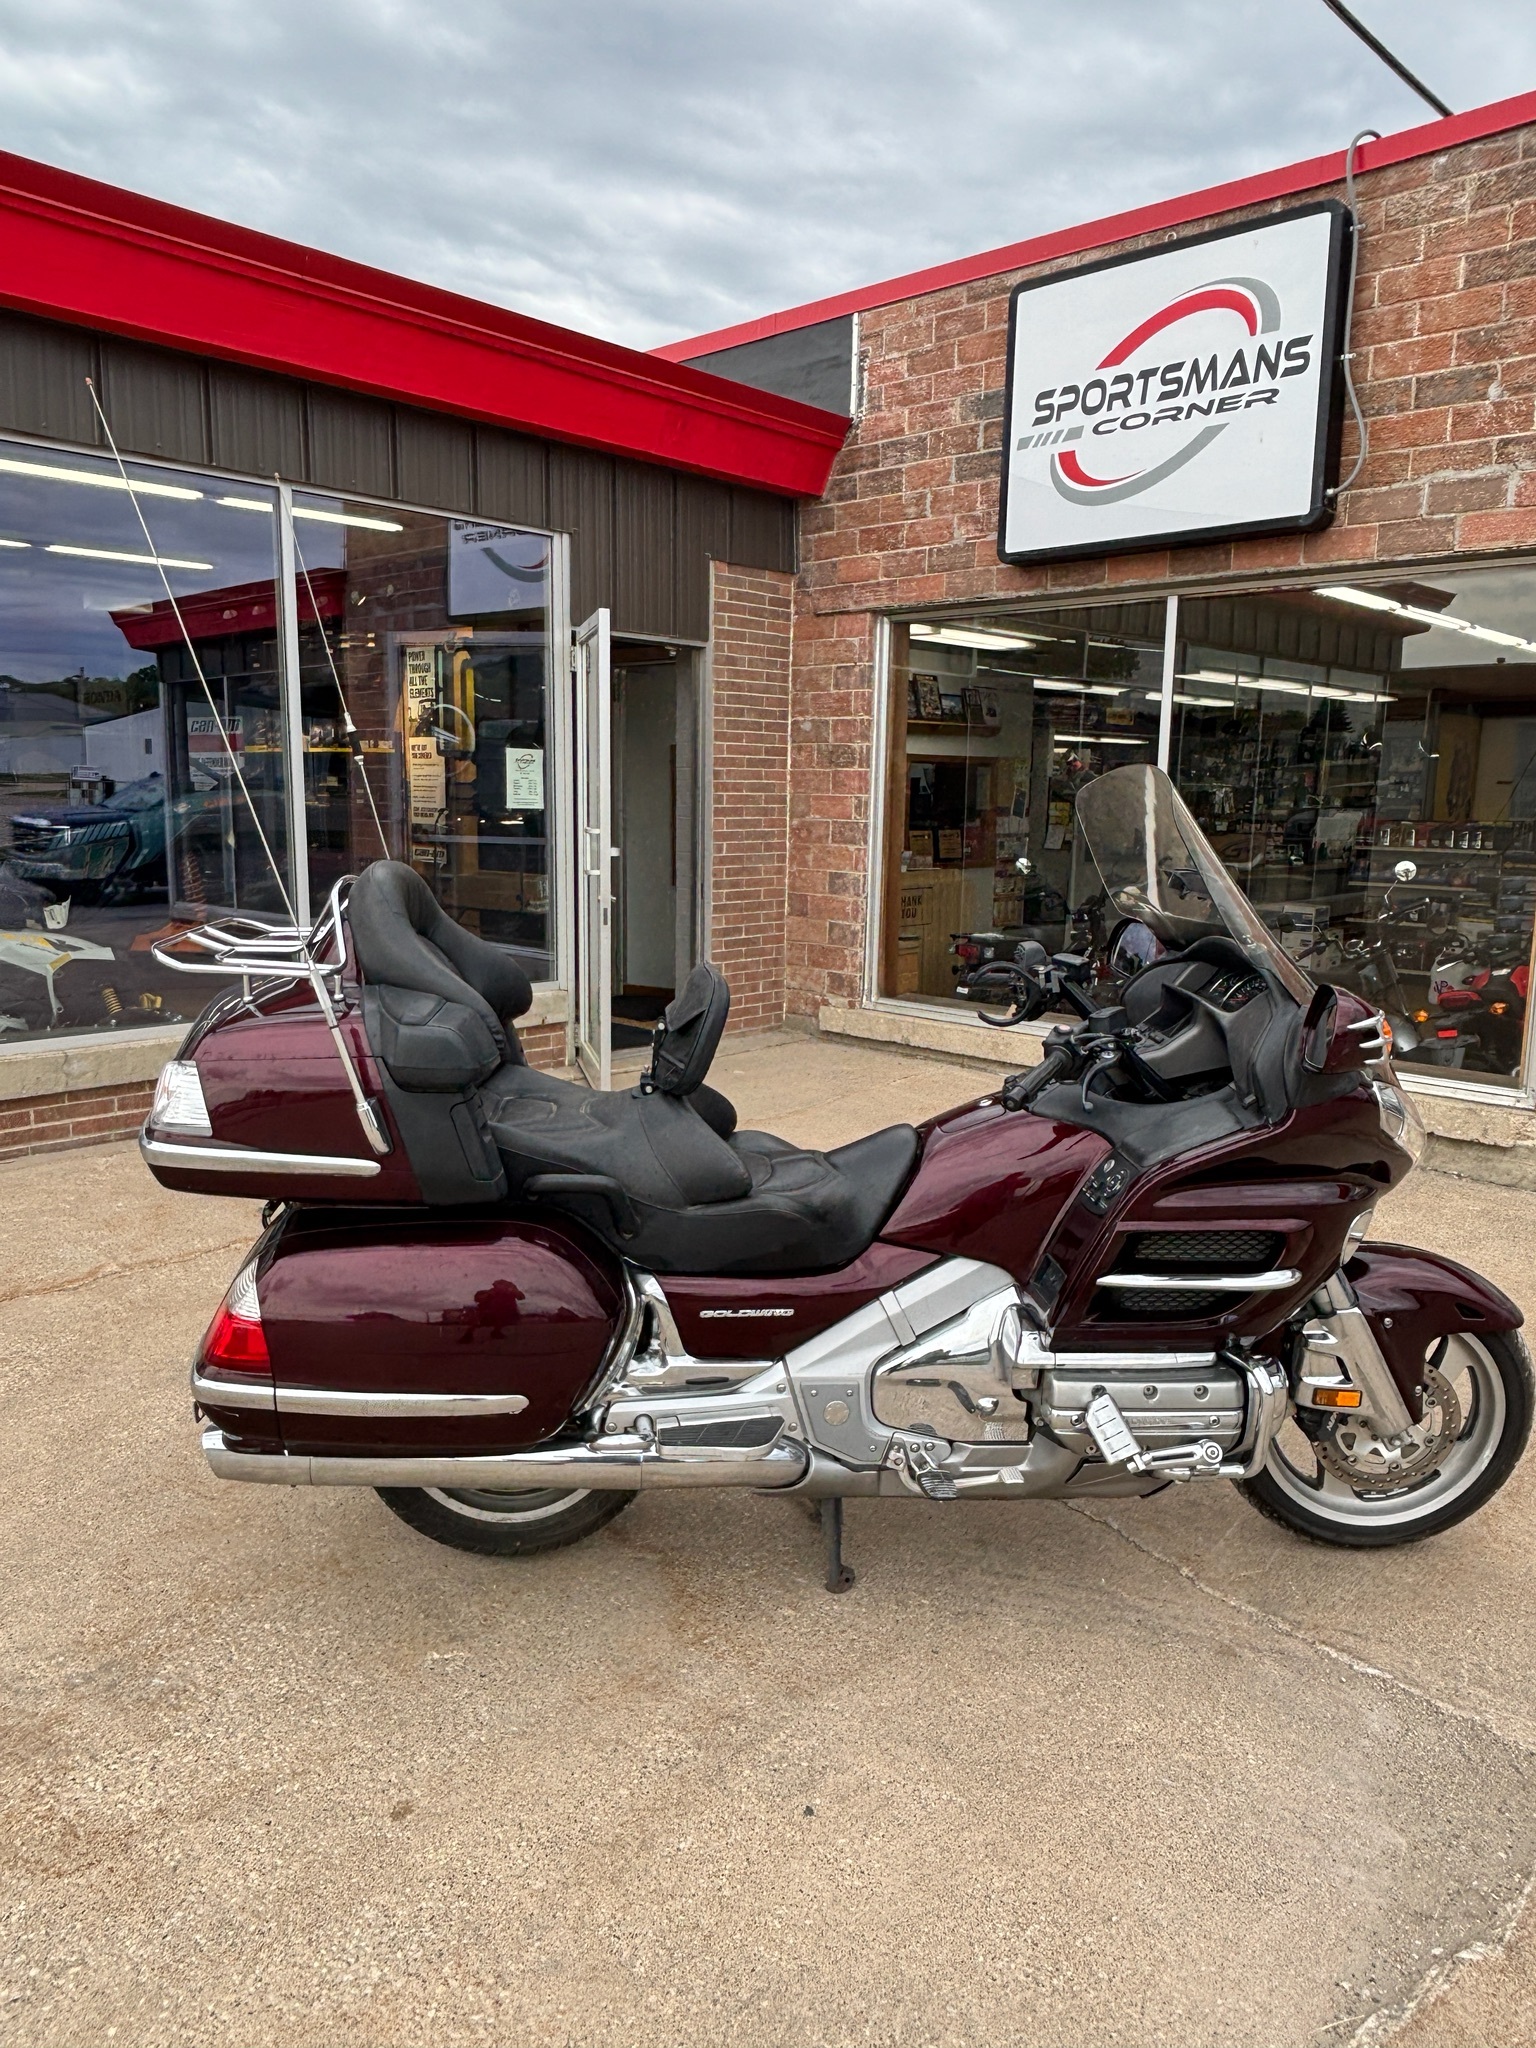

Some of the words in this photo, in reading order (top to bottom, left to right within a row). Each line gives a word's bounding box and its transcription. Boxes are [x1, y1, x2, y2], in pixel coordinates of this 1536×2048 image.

[1031, 334, 1314, 427] SPORTSMANS
[1092, 387, 1280, 436] CORNER
[190, 718, 240, 733] can-m
[901, 895, 922, 907] HANK
